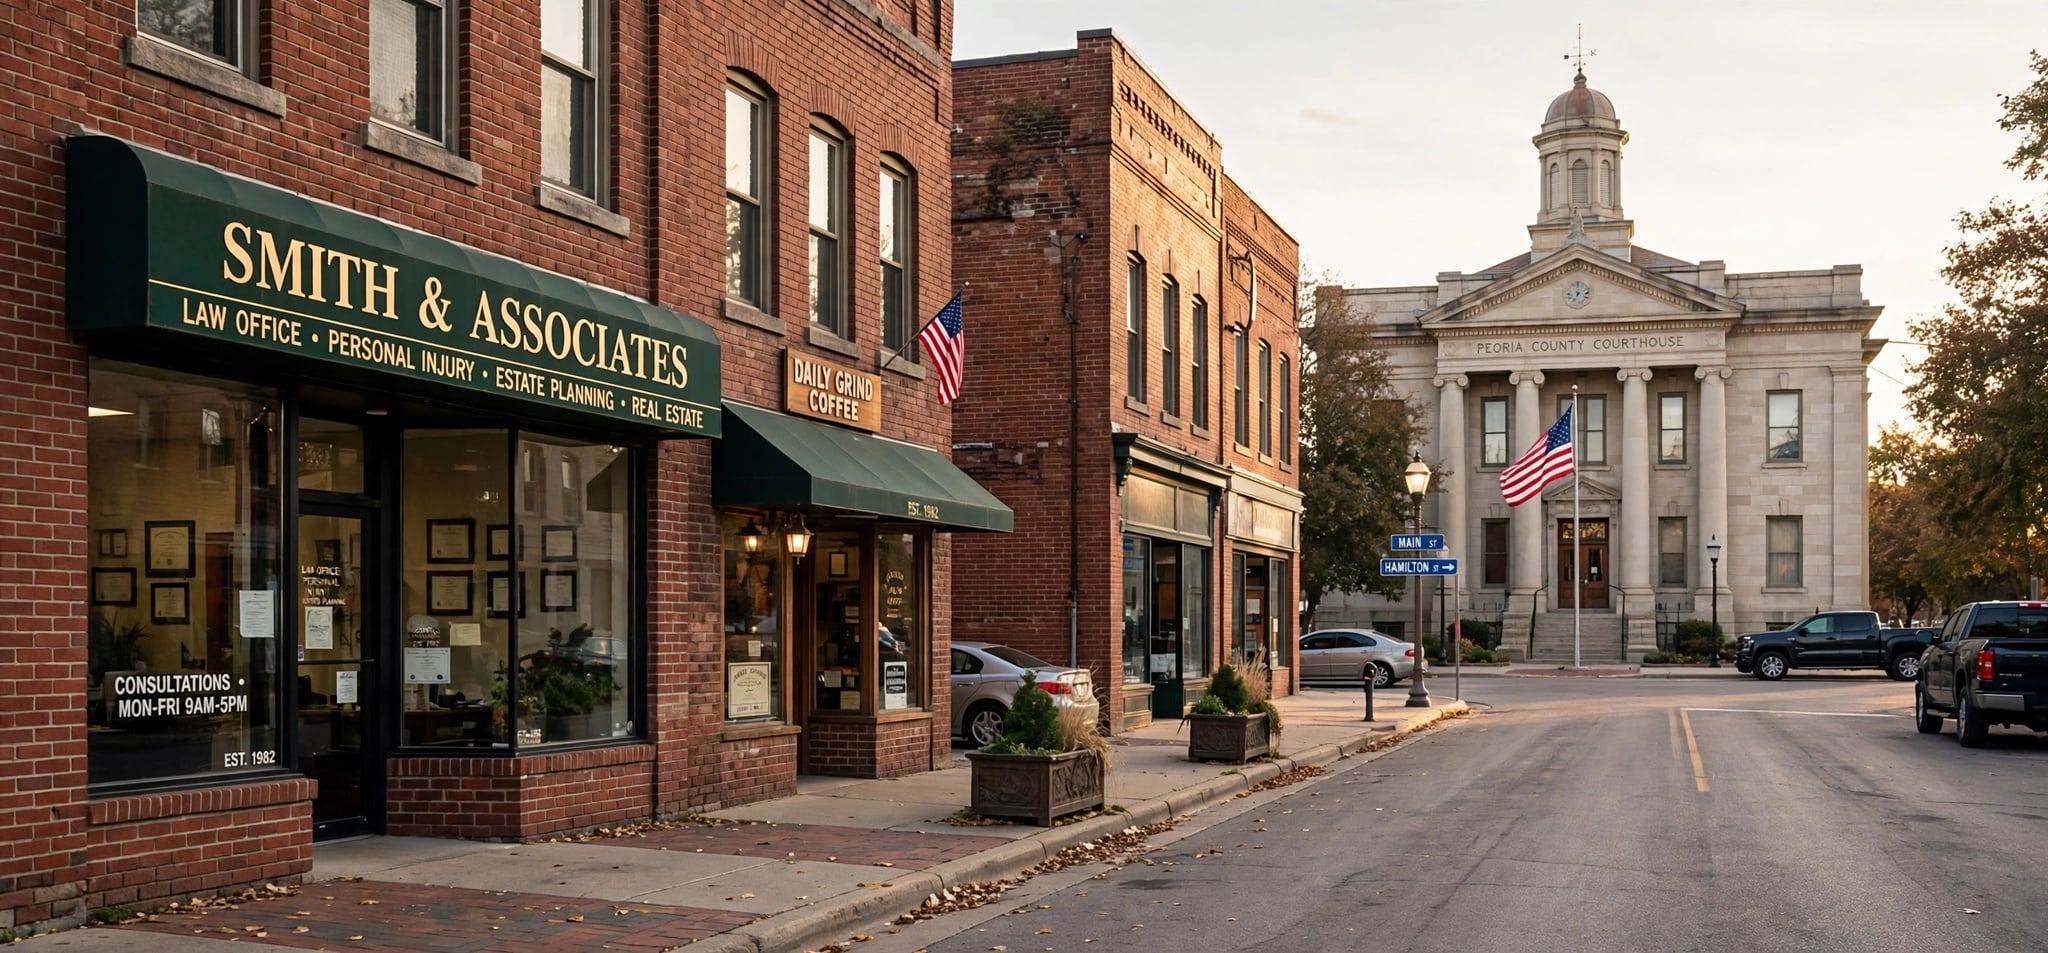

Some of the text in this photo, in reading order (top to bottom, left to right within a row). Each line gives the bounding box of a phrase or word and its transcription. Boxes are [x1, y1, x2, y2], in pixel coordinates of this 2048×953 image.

[223, 222, 689, 389] SMITH & ASSOCIATES
[1477, 335, 1684, 354] PEORIA COUNTY COURTHOUSE
[183, 297, 704, 429] LAW OFFICE PERSONAL INJURY ESTATE PLANNING REAL ESTATE
[793, 357, 873, 402] DAILY GRIND
[809, 388, 859, 421] COFFEE
[1398, 537, 1438, 548] MAIN ST
[1384, 561, 1439, 573] HAMILTON ST
[114, 673, 231, 695] CONSULTATIONS
[118, 694, 248, 718] MON-FRI 9AM-5PM
[224, 750, 276, 768] EST. 1982
